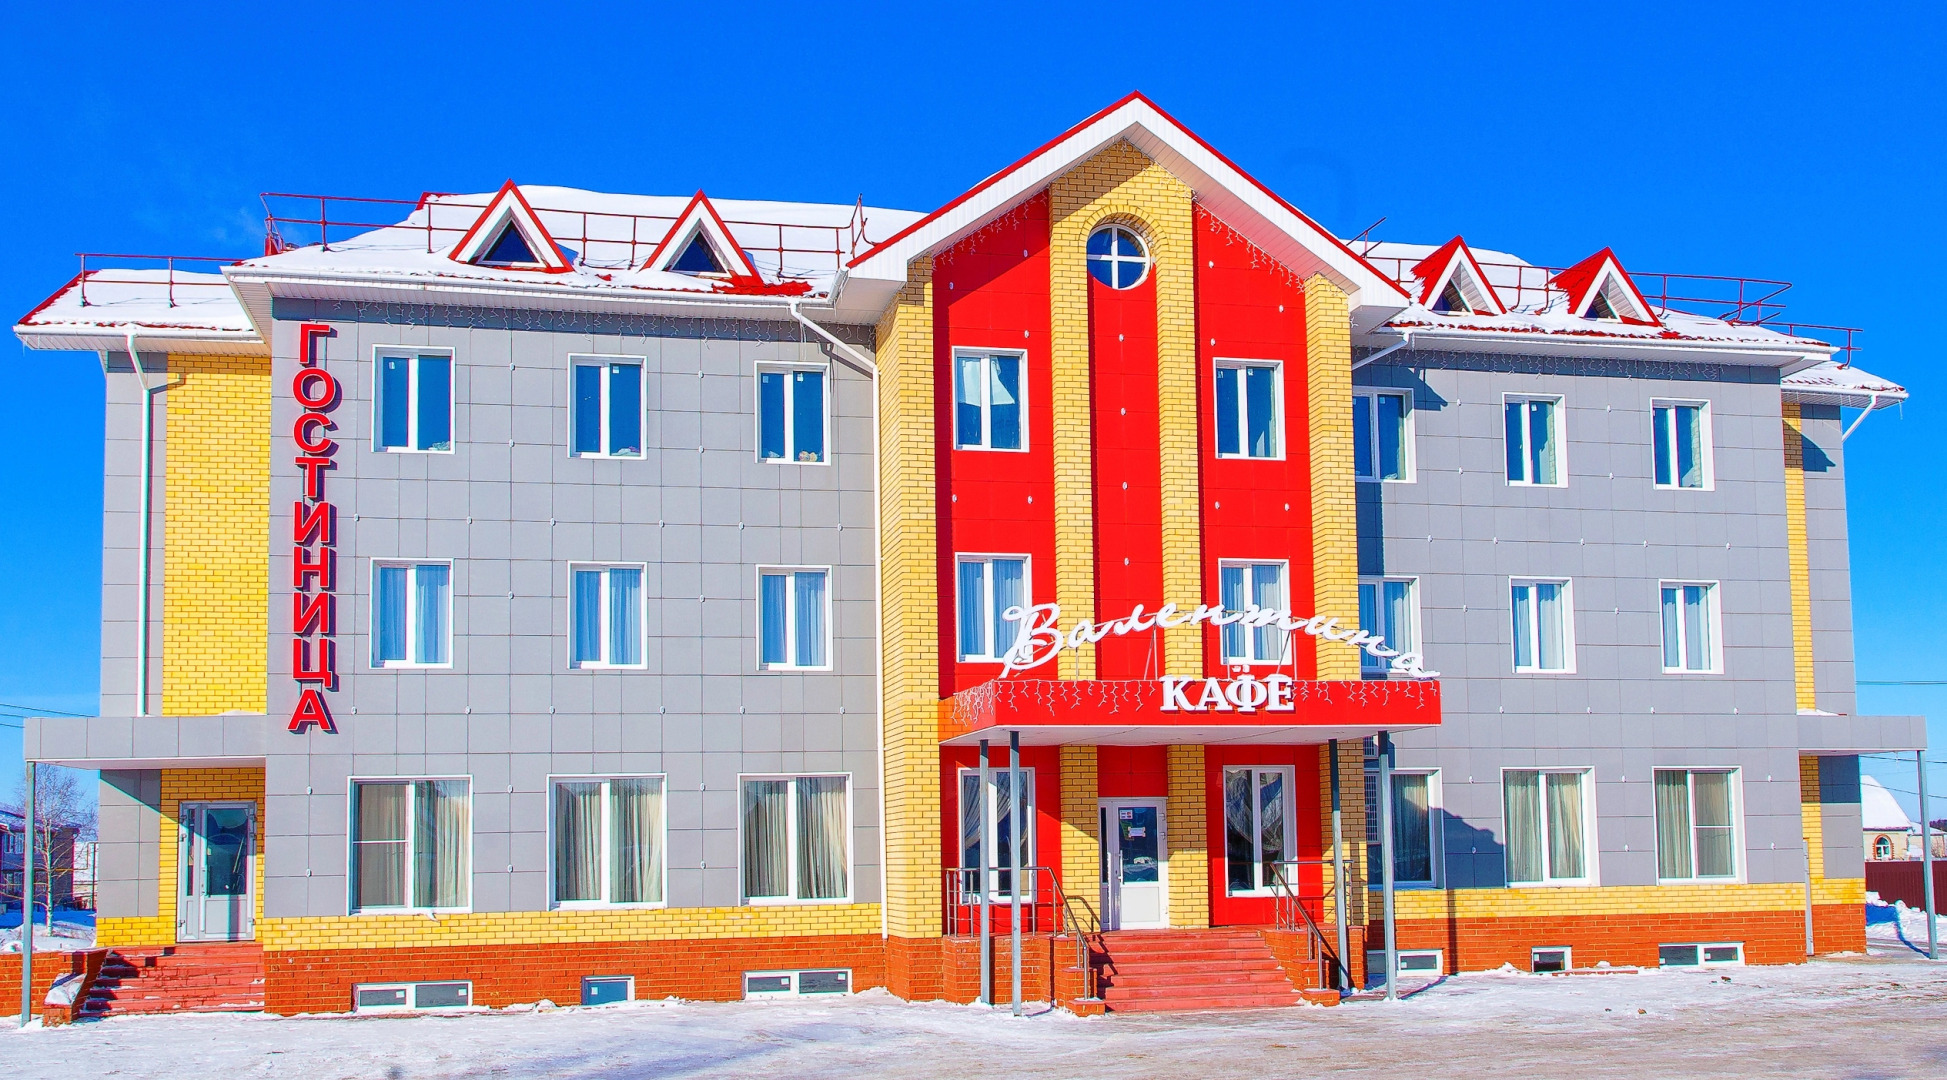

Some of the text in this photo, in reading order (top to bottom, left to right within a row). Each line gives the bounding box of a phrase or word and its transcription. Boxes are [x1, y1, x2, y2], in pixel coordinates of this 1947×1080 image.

[287, 323, 338, 732] ГОСТИНИЦА
[999, 601, 1441, 679] Валентина
[1159, 674, 1296, 713] КАФЕ
